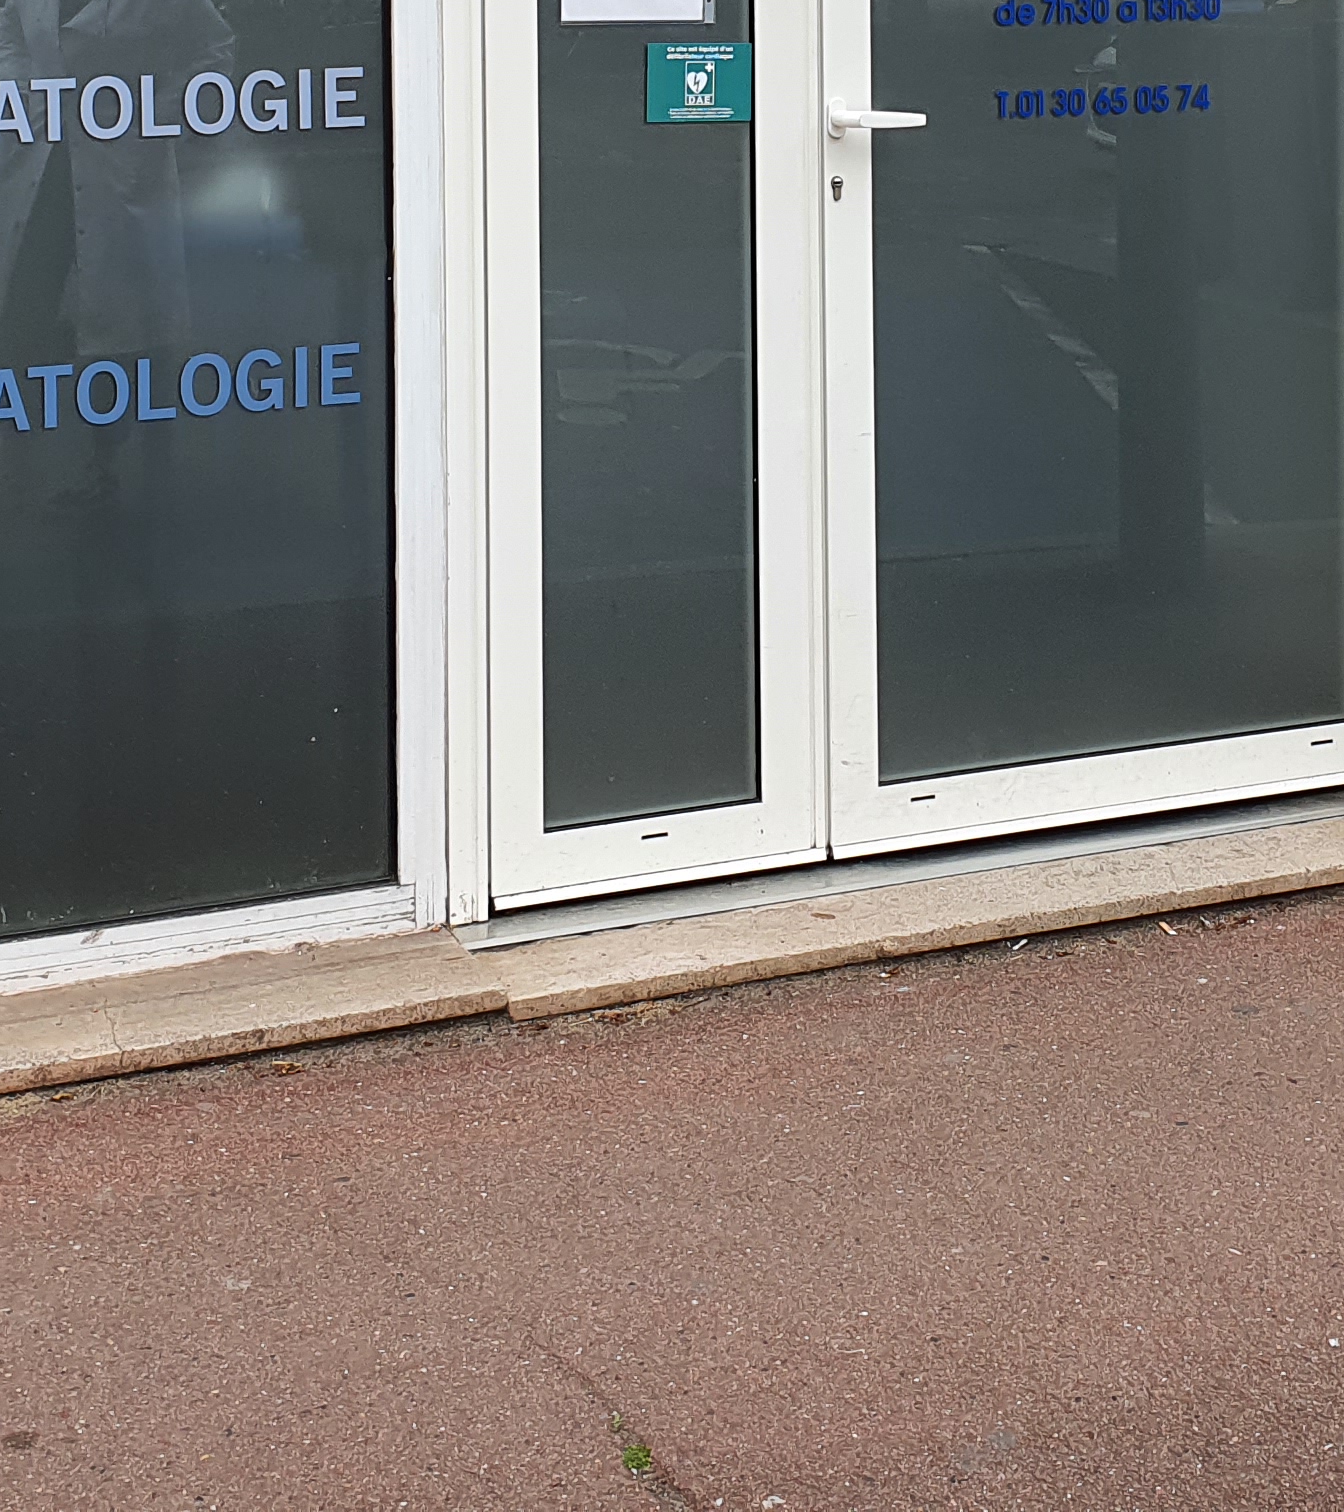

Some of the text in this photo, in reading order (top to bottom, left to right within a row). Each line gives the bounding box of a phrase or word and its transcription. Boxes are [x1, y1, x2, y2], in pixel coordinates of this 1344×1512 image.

[689, 96, 711, 104] DAE
[1052, 87, 1085, 117] 30
[1095, 86, 1128, 115] 65
[1136, 84, 1169, 114] 05
[1178, 83, 1211, 112] 74
